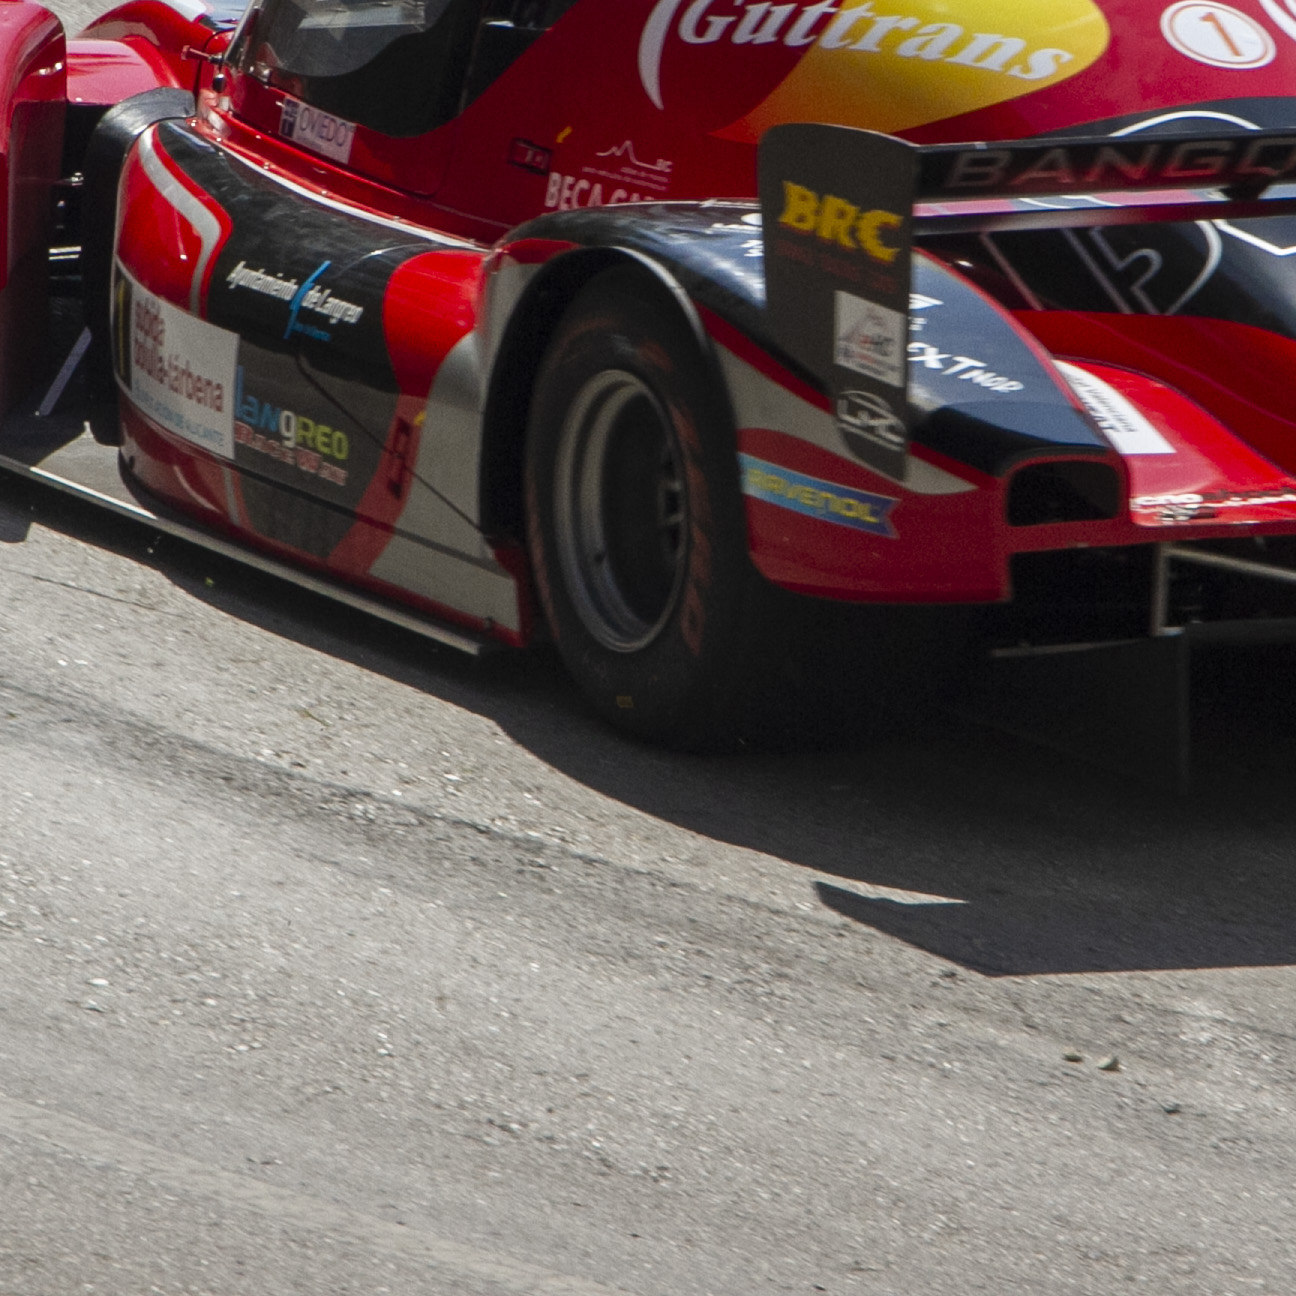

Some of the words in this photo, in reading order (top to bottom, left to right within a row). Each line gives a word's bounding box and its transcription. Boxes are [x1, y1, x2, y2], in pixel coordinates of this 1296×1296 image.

[1199, 12, 1245, 58] 1
[299, 107, 347, 147] OVIEDO
[778, 180, 904, 263] BRC
[226, 261, 299, 301] Ayuntamiento
